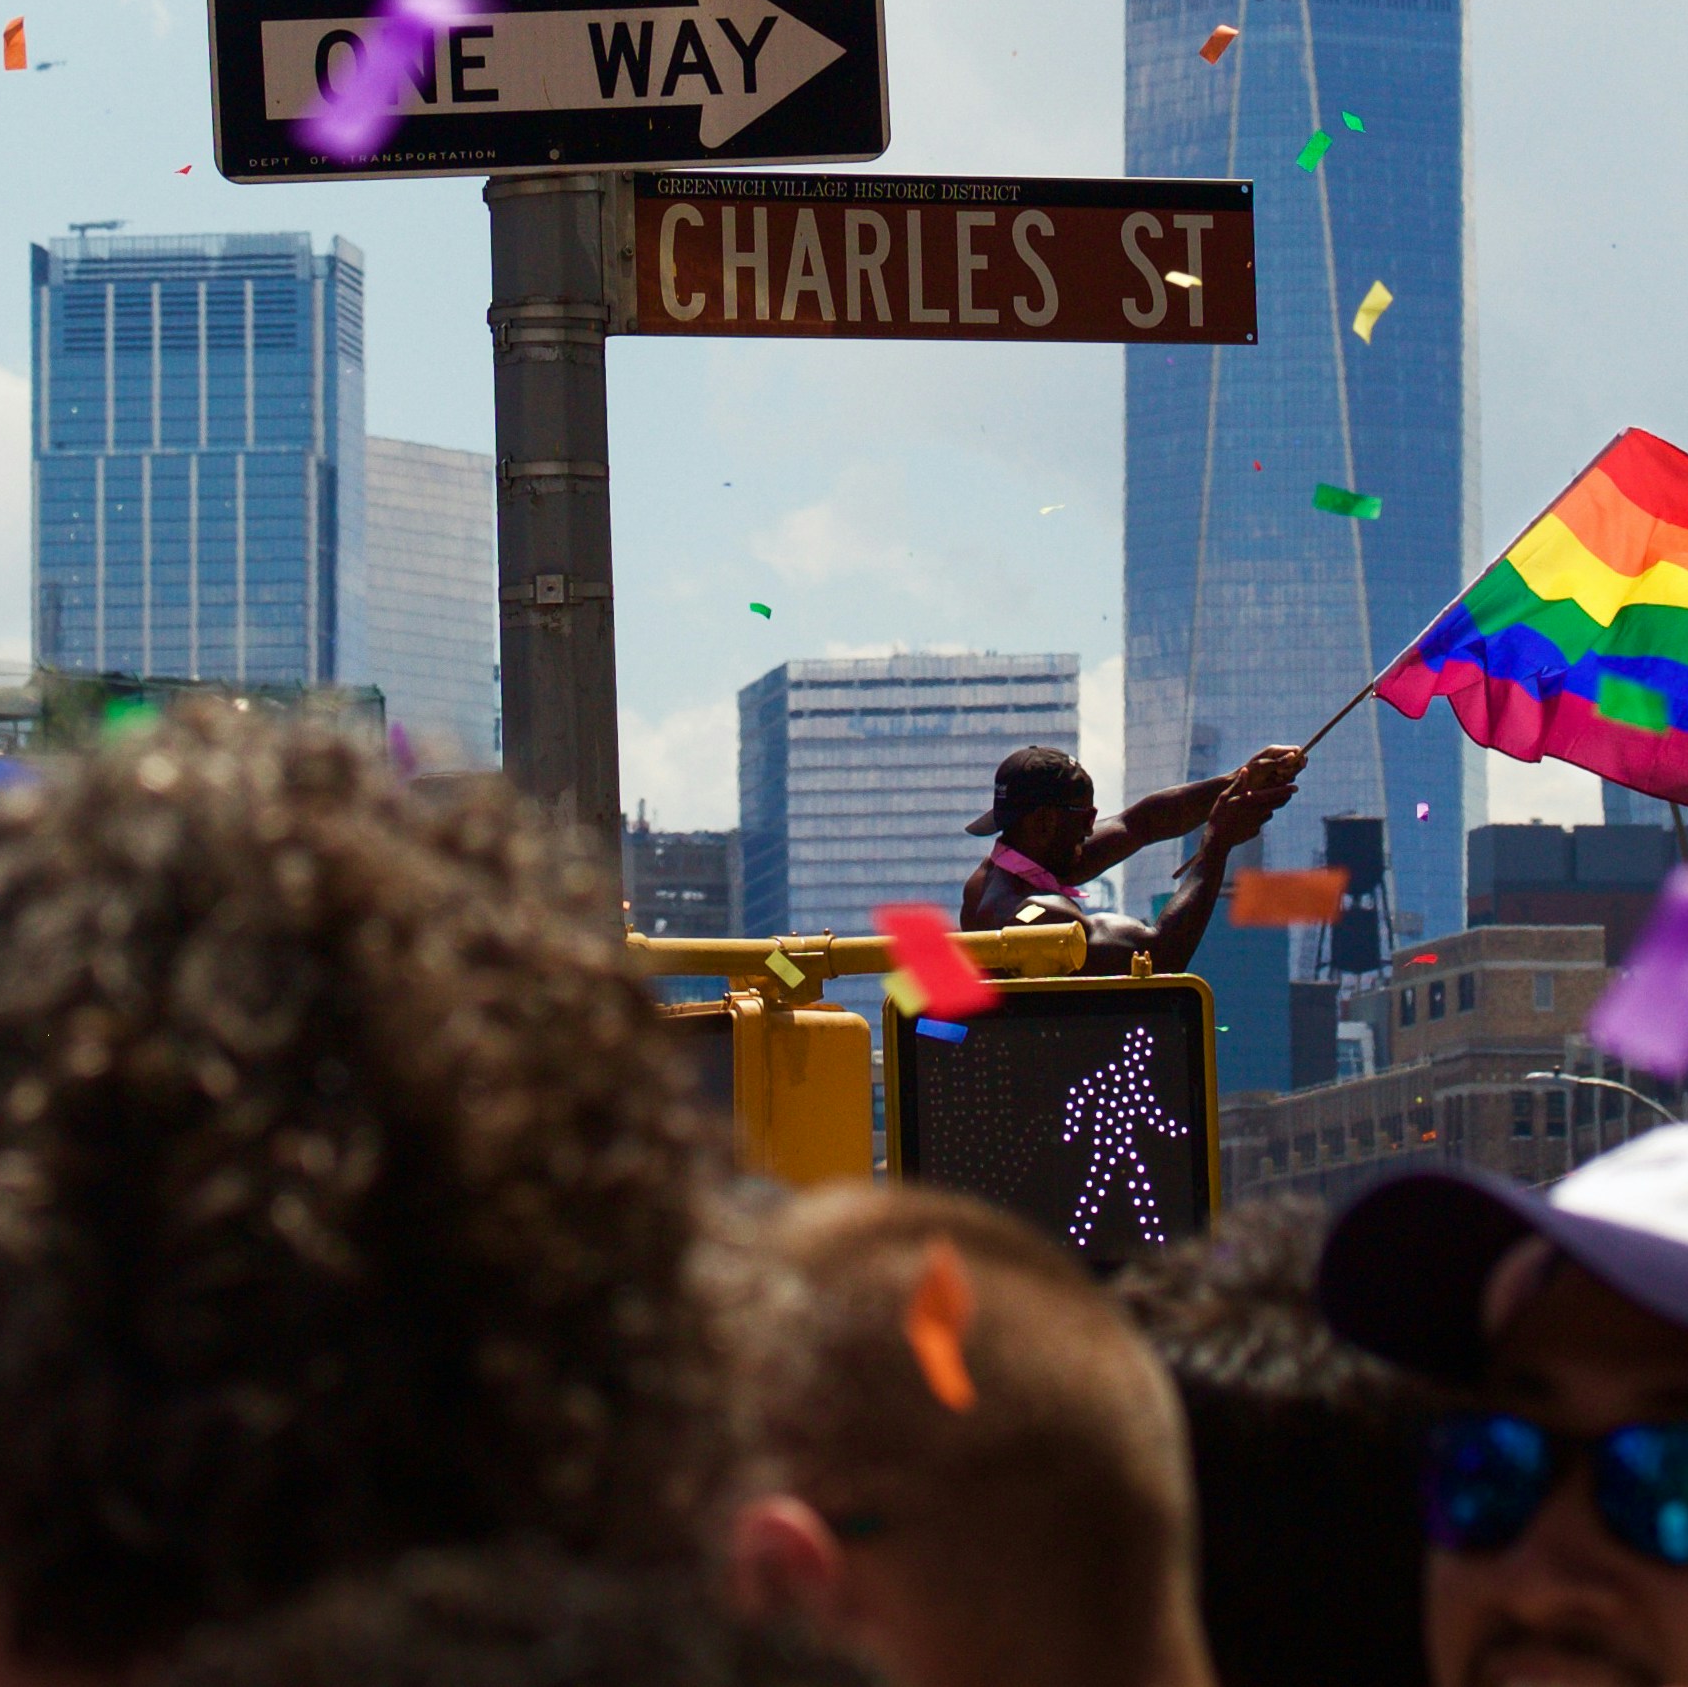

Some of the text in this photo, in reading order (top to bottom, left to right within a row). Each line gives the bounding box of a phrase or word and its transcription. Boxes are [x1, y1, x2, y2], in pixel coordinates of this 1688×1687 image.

[314, 16, 779, 106] ONE WAY
[249, 150, 496, 167] DEPT OF TRANSPORTATION
[657, 178, 1021, 202] GREENWICH VILLAGE HISTORIC DISTRICT
[659, 203, 1213, 329] CHARLES ST
